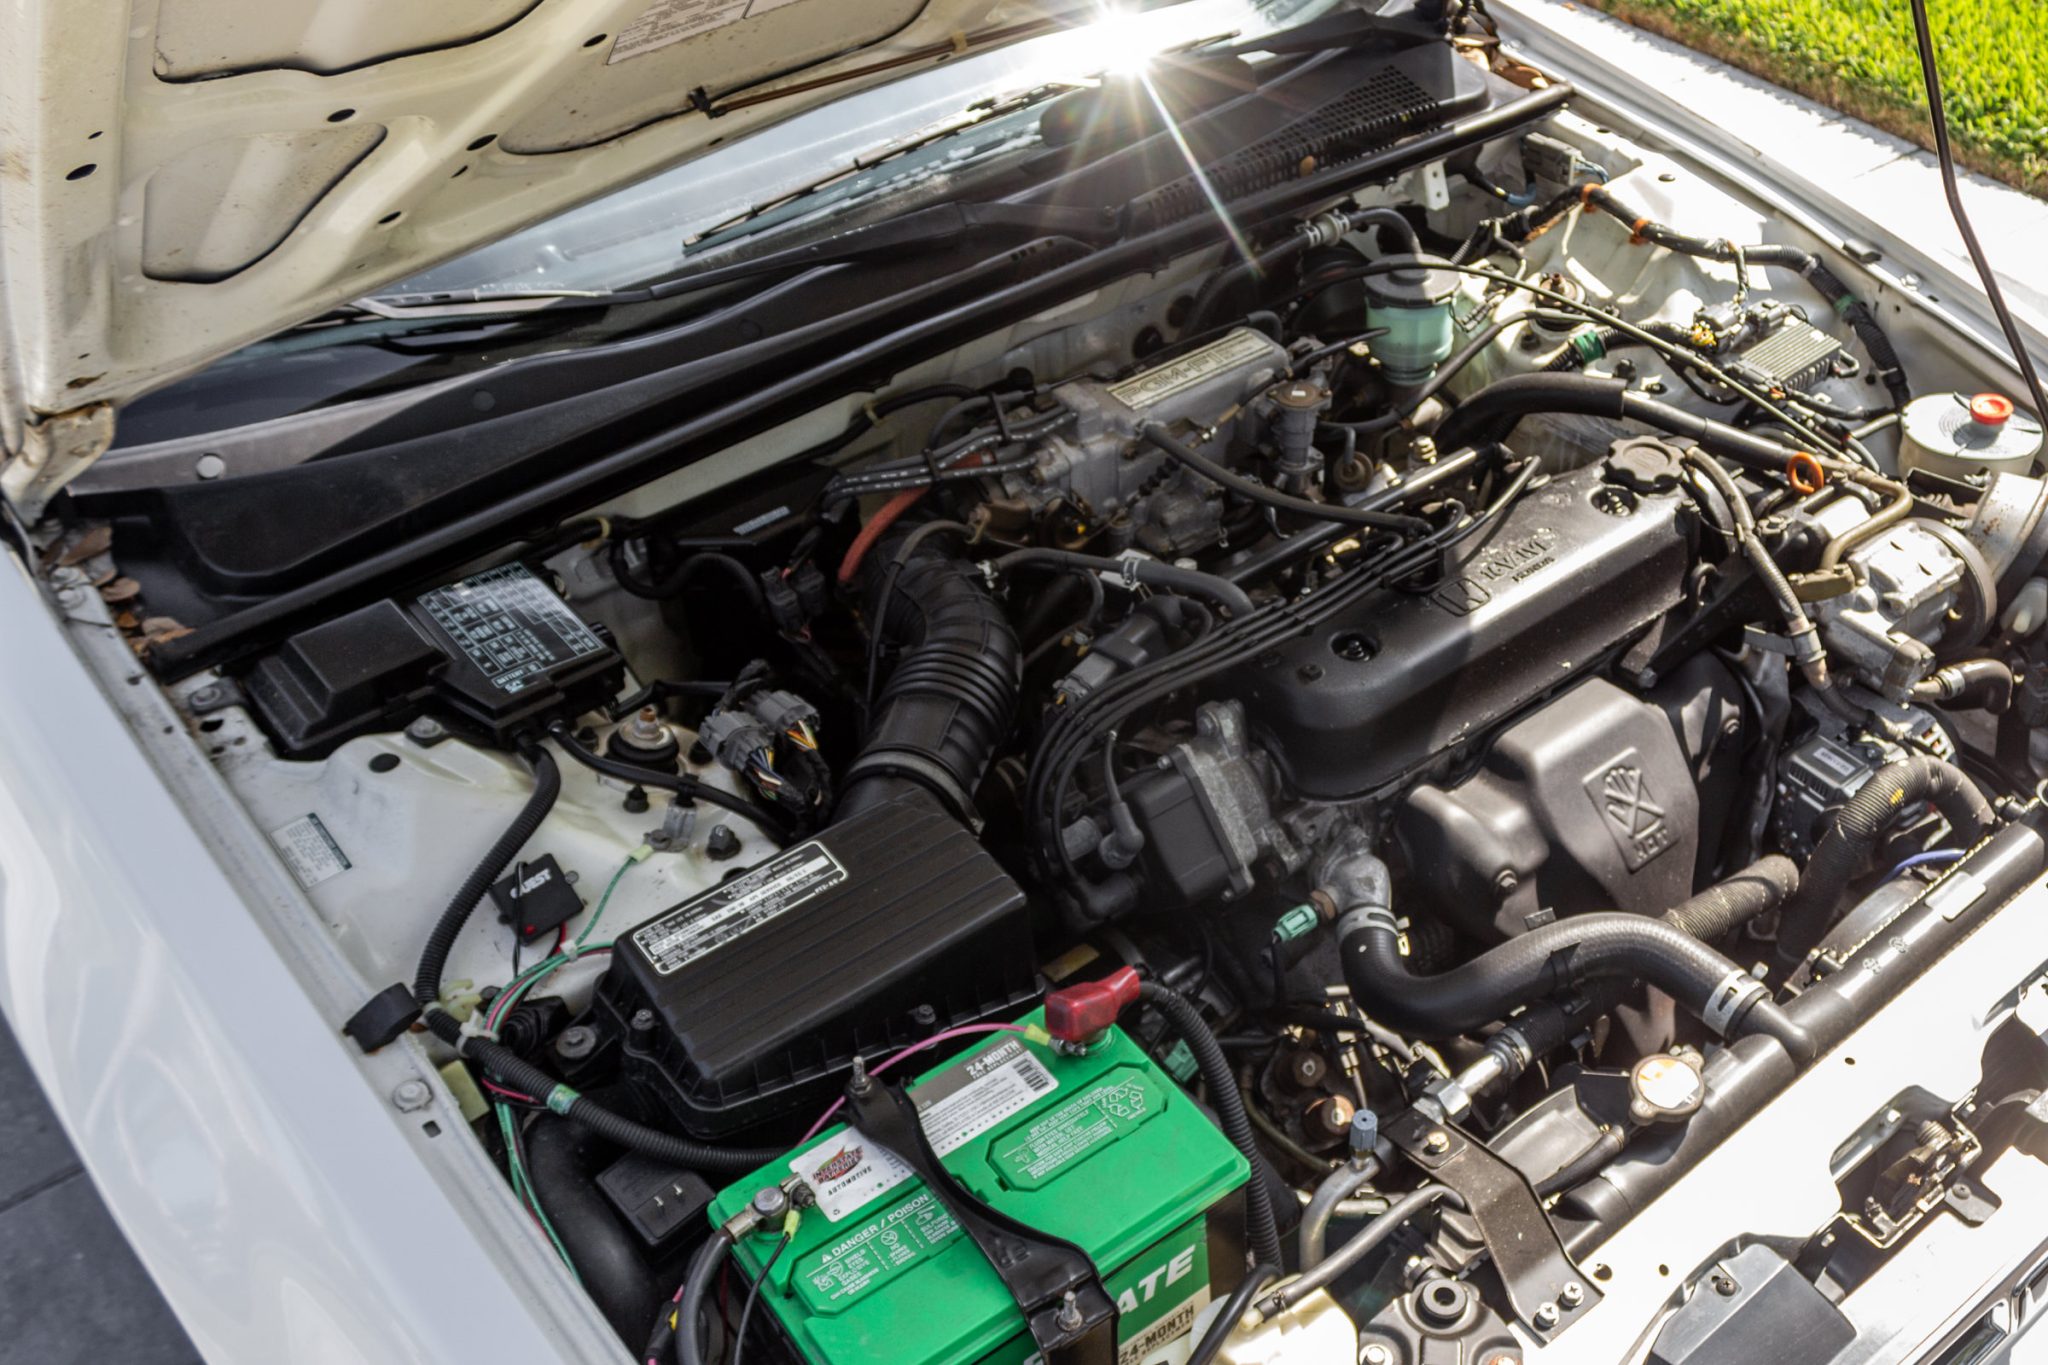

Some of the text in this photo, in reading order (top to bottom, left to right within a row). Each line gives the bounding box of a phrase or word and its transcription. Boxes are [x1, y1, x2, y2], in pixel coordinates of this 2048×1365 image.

[1117, 349, 1225, 402] PGM-FI
[1634, 826, 1669, 862] HOT
[965, 1038, 1020, 1076] 24-MONTH
[812, 1145, 864, 1181] INTERSTATE
[818, 1155, 863, 1185] BATTERIES
[828, 1165, 873, 1196] AUTOMOTIVE
[830, 1223, 879, 1256] DANGER
[886, 1193, 928, 1222] POISON
[1118, 1304, 1195, 1365] 24-MONTH
